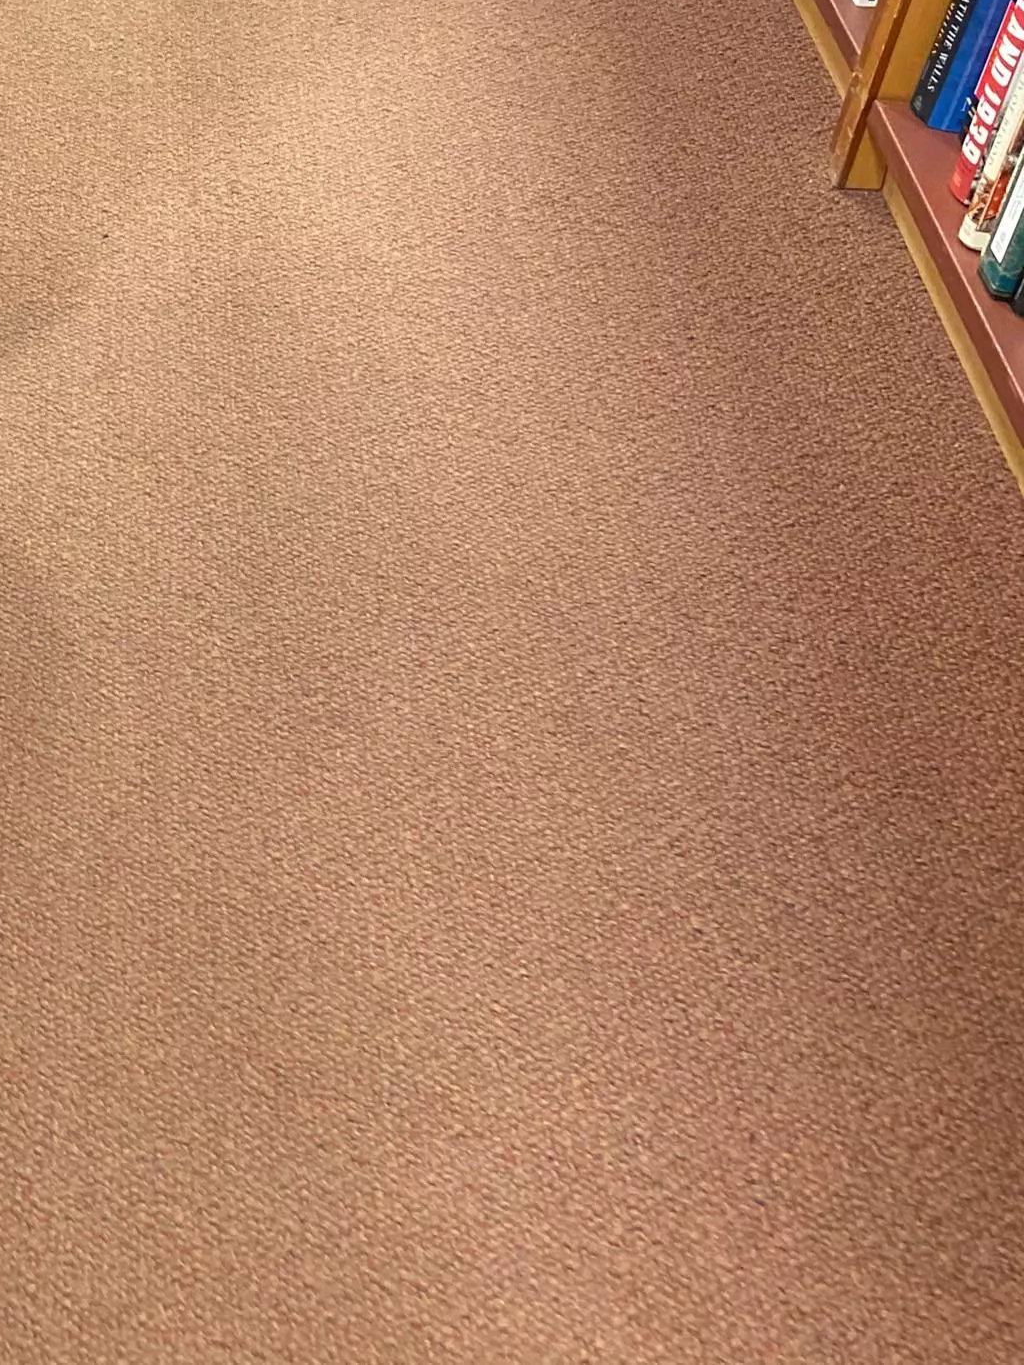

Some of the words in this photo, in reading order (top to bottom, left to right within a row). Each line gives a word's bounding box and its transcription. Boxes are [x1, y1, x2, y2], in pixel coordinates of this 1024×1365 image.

[942, 23, 959, 50] THE
[925, 51, 948, 92] WALLS
[962, 83, 1001, 165] 1939
